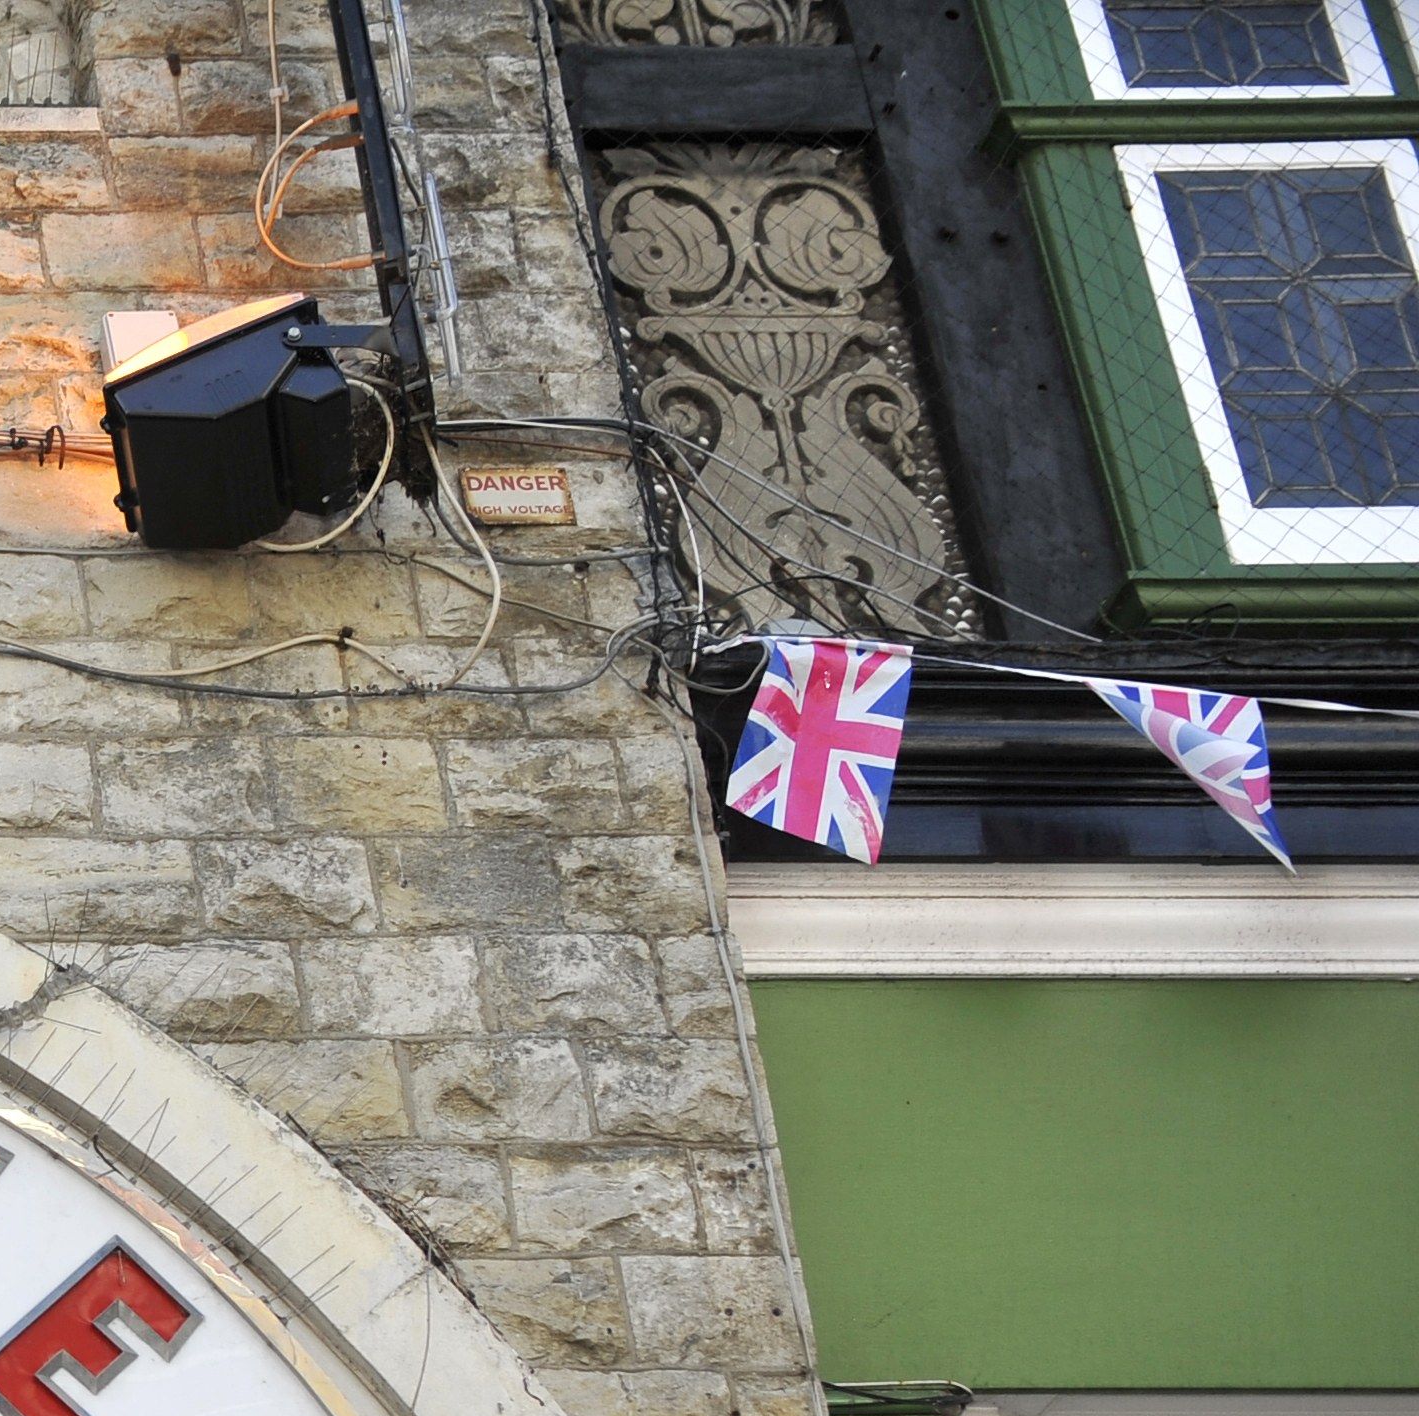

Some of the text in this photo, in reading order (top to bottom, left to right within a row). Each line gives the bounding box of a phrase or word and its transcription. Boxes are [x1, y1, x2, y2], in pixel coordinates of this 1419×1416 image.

[466, 475, 565, 491] DANGER
[469, 504, 574, 515] HIGH VOLTAGE
